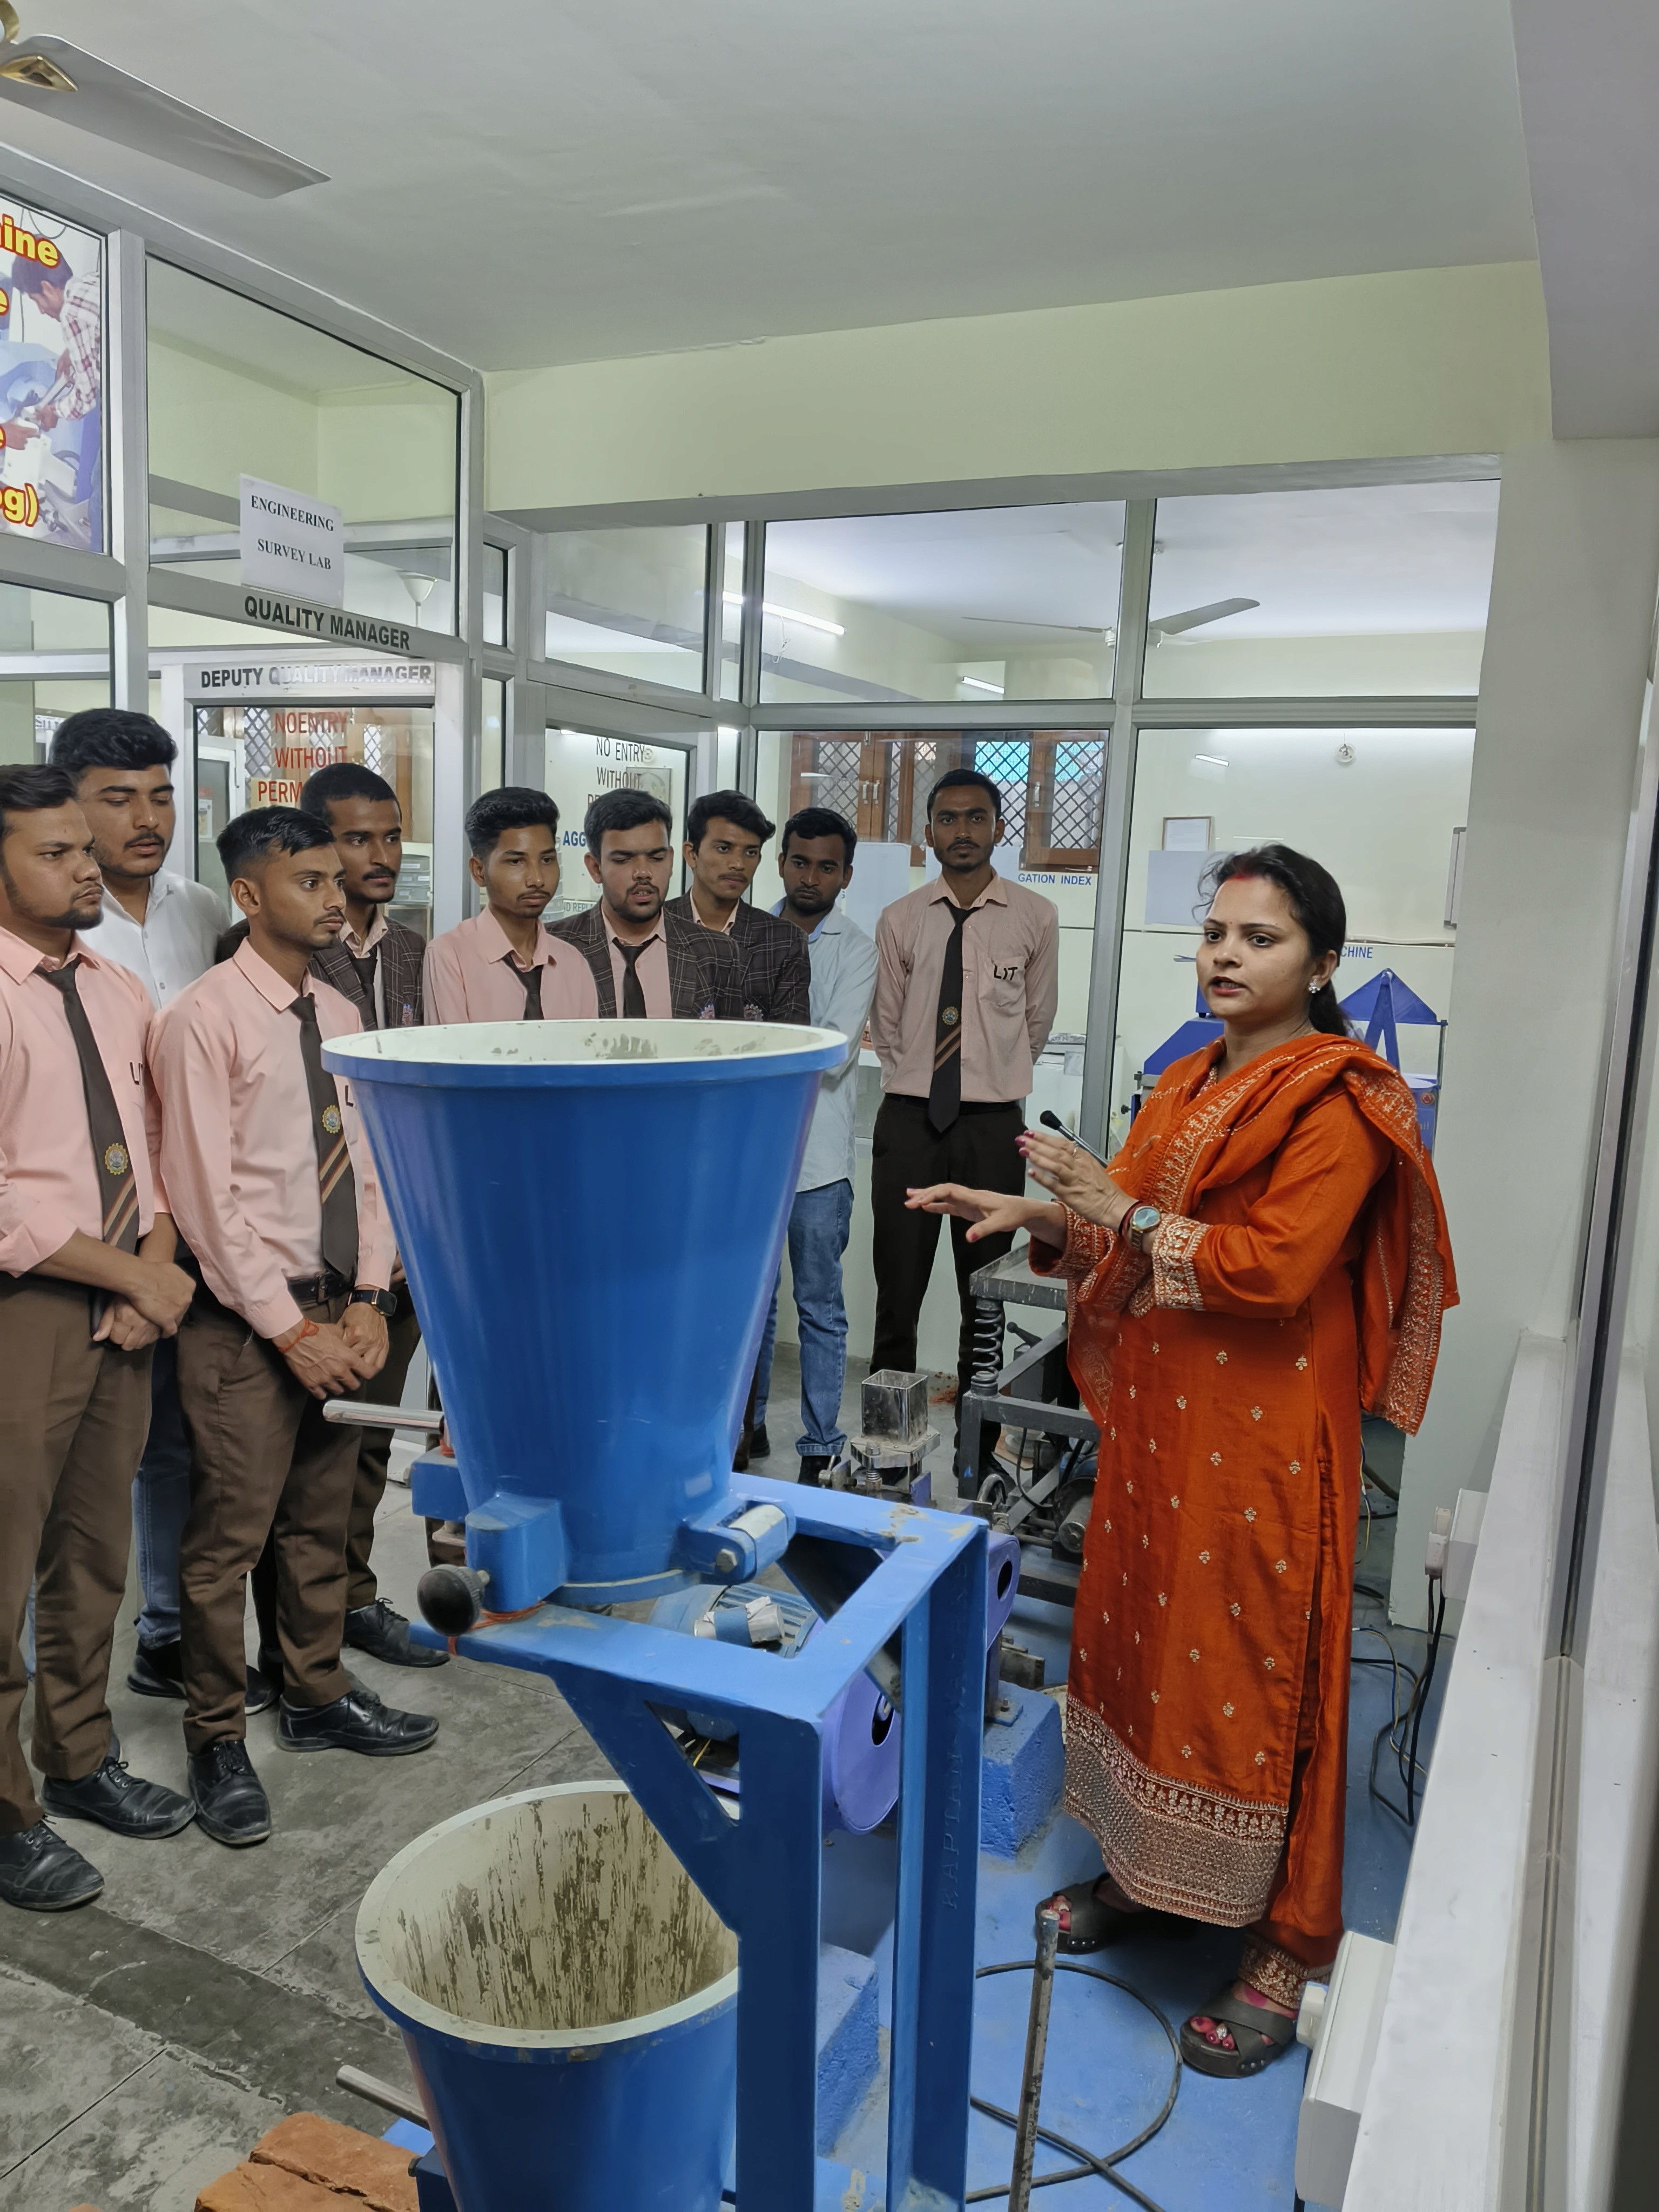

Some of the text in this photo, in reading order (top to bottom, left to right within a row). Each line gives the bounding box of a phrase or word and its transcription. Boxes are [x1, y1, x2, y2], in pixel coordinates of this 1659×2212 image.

[0, 213, 60, 269] ine
[0, 482, 39, 527] g)
[251, 495, 334, 531] ENGINEERING
[257, 538, 331, 569] SURVEY LAB
[244, 595, 410, 650] QUALITY MANAGER
[201, 664, 431, 688] DEPUTY QUALITY MANAGER
[274, 746, 347, 769] WITHOUT
[596, 737, 644, 763] NO ENTRY
[597, 766, 642, 790] WITHOUT
[1018, 873, 1092, 885] GATION INDEX
[994, 964, 1018, 981] LIT
